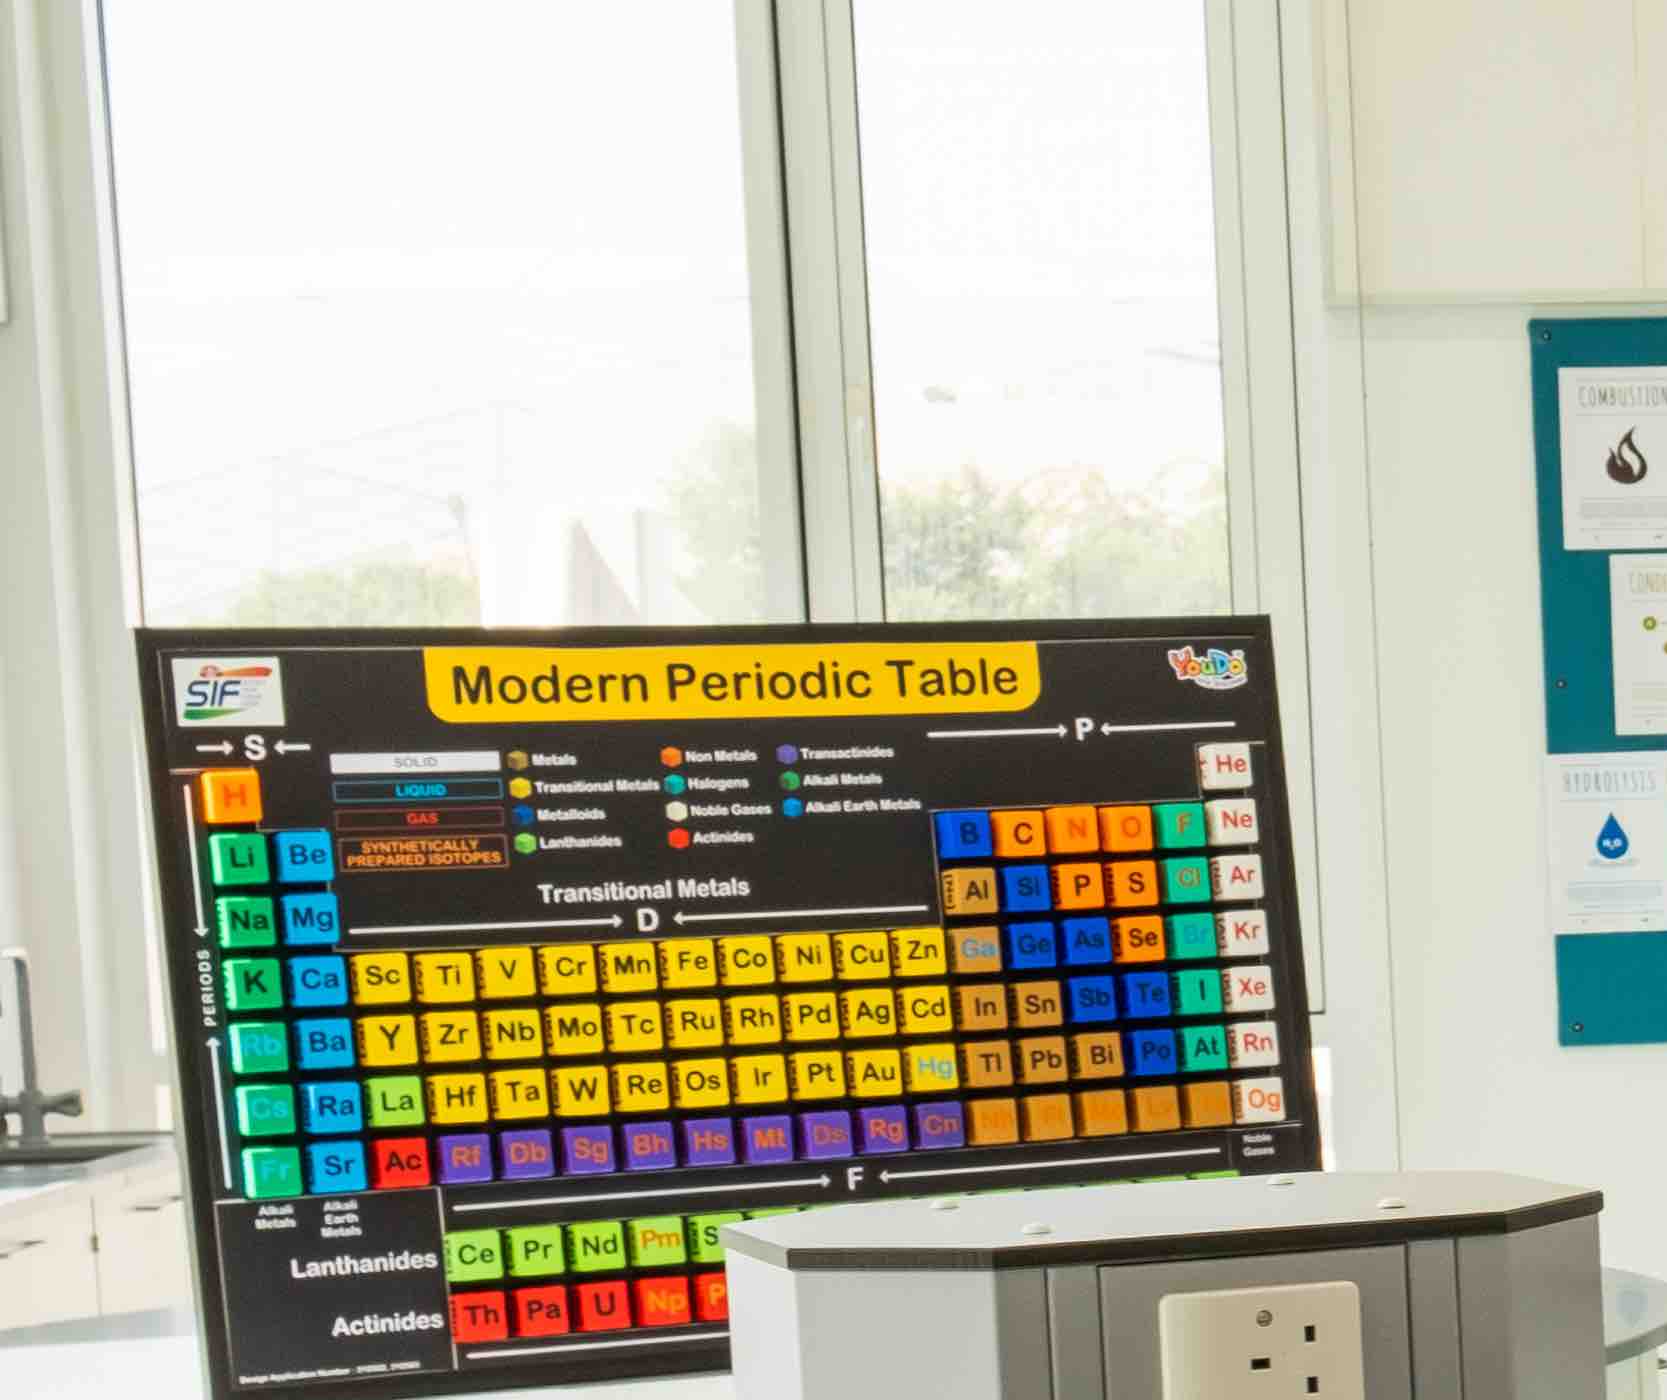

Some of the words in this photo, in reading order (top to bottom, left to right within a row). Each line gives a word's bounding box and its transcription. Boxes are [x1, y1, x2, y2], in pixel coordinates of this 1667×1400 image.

[453, 665, 648, 704] Modern
[667, 661, 871, 702] Periodic
[886, 659, 1017, 695] Table
[186, 680, 241, 707] SIF
[1075, 720, 1093, 739] P
[244, 734, 267, 760] S
[686, 751, 712, 762] Non
[714, 750, 757, 761] Metals
[802, 747, 894, 759] Transactinides
[393, 757, 437, 768] SOLID
[532, 754, 576, 765] Metals
[1216, 755, 1246, 772] He
[396, 784, 446, 796] LIQUID
[535, 781, 614, 793] Transitional
[616, 779, 660, 791] Metals
[688, 777, 749, 791] Halogens
[803, 774, 838, 786] Alkali
[841, 774, 882, 784] Metals
[1562, 770, 1657, 794] HYDROLYSIS
[225, 785, 247, 806] H
[806, 801, 841, 812] Alkali
[843, 800, 878, 811] Earth
[880, 799, 921, 810] Metals
[407, 813, 438, 824] GAS
[691, 804, 729, 816] Noble
[731, 804, 772, 815] Gases
[693, 831, 753, 844] Actinides
[1013, 823, 1033, 845] C
[1222, 810, 1253, 828] Ne
[362, 840, 479, 854] SYNTHETICALLY
[540, 836, 622, 849] Lanthanides
[230, 846, 254, 868] Li
[289, 845, 326, 865] Be
[347, 853, 426, 866] PREPARED
[429, 851, 501, 865] ISOTOPES
[1075, 877, 1090, 895] P
[1129, 872, 1144, 893] S
[1231, 866, 1255, 884] Ar
[538, 881, 672, 904] Transitional
[678, 879, 750, 899] Metals
[231, 910, 268, 932] Na
[293, 908, 333, 931] Mg
[638, 910, 659, 930] D
[245, 970, 266, 992] K
[303, 967, 340, 989] Ca
[366, 967, 400, 986] Sc
[436, 966, 460, 986] Ti
[499, 960, 517, 979] V
[557, 957, 587, 976] Cr
[615, 957, 651, 975] Mn
[678, 951, 707, 970] Fe
[733, 948, 767, 968] Co
[797, 947, 822, 965] Ni
[851, 945, 884, 964] Cu
[908, 941, 938, 959] Zn
[1129, 927, 1158, 947] Se
[1235, 921, 1261, 940] Kr
[199, 949, 217, 1027] PERIODS
[310, 1033, 346, 1053] Ba
[379, 1025, 399, 1048] Y
[440, 1026, 468, 1045] Zr
[498, 1022, 535, 1042] Nb
[560, 1019, 596, 1038] Mo
[622, 1016, 655, 1035] Tc
[682, 1012, 715, 1031] Ru
[740, 1008, 773, 1028] Rh
[800, 1005, 831, 1025] Pd
[856, 1002, 889, 1024] Ag
[912, 998, 945, 1016] Cd
[976, 998, 996, 1015] In
[1025, 996, 1055, 1015] Sn
[1239, 978, 1266, 996] Xe
[319, 1096, 354, 1116] Ra
[381, 1092, 414, 1111] La
[446, 1088, 474, 1107] Hf
[506, 1083, 540, 1103] Ta
[569, 1078, 596, 1099] W
[628, 1077, 662, 1095] Re
[686, 1072, 720, 1091] Os
[753, 1068, 772, 1086] Ir
[808, 1064, 834, 1083] Pt
[862, 1063, 895, 1081] Au
[918, 1058, 953, 1079] Hg
[1031, 1051, 1062, 1070] Pb
[1091, 1046, 1113, 1064] Bi
[1195, 1038, 1219, 1057] At
[1244, 1034, 1273, 1051] Rn
[324, 1156, 356, 1176] Sr
[386, 1152, 421, 1171] Ac
[1249, 1090, 1281, 1110] Og
[848, 1169, 862, 1190] F
[458, 1245, 494, 1264] Ce
[524, 1241, 552, 1260] Pr
[582, 1236, 617, 1256] Nd
[290, 1252, 438, 1279] Lanthanides
[466, 1306, 499, 1326] Th
[529, 1302, 560, 1321] Pa
[594, 1293, 615, 1315] U
[332, 1312, 443, 1337] Actinides
